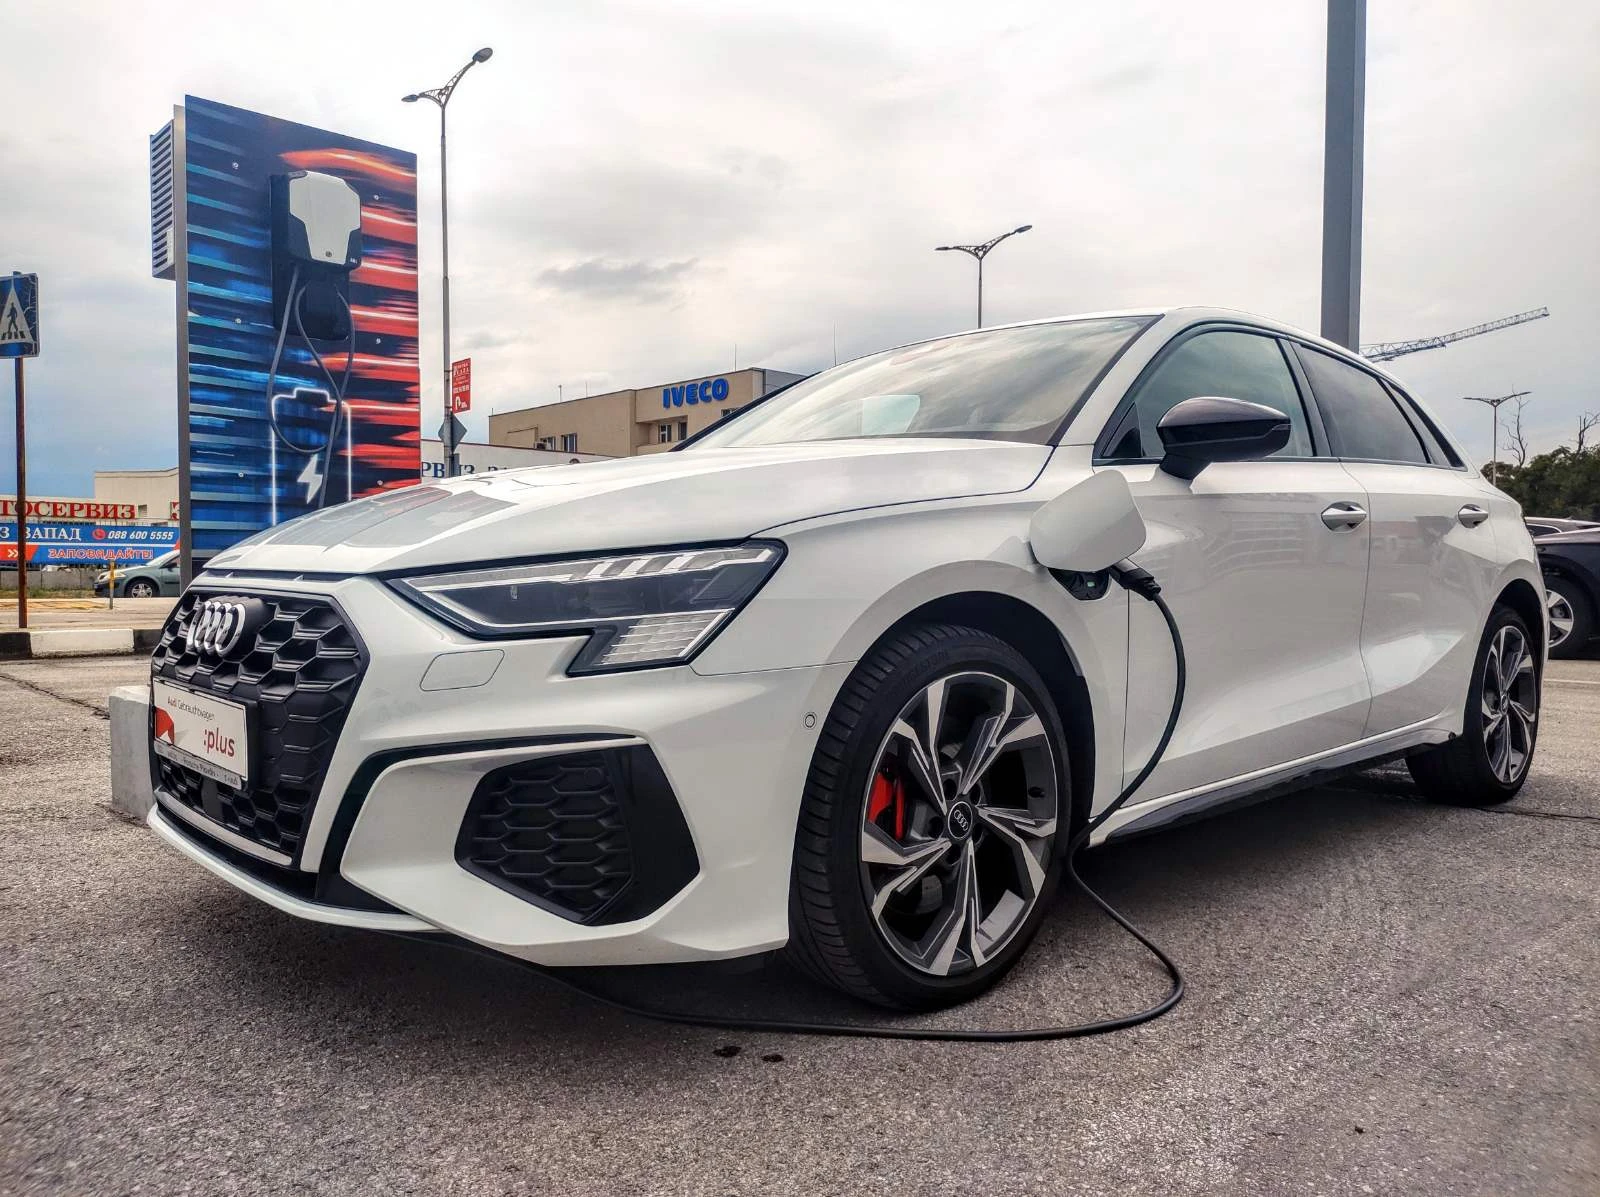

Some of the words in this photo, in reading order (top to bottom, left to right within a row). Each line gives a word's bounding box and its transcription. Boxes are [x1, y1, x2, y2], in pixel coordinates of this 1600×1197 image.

[663, 378, 729, 409] IVECO
[108, 530, 128, 540] 088
[129, 531, 148, 540] 600
[149, 531, 175, 540] 5555
